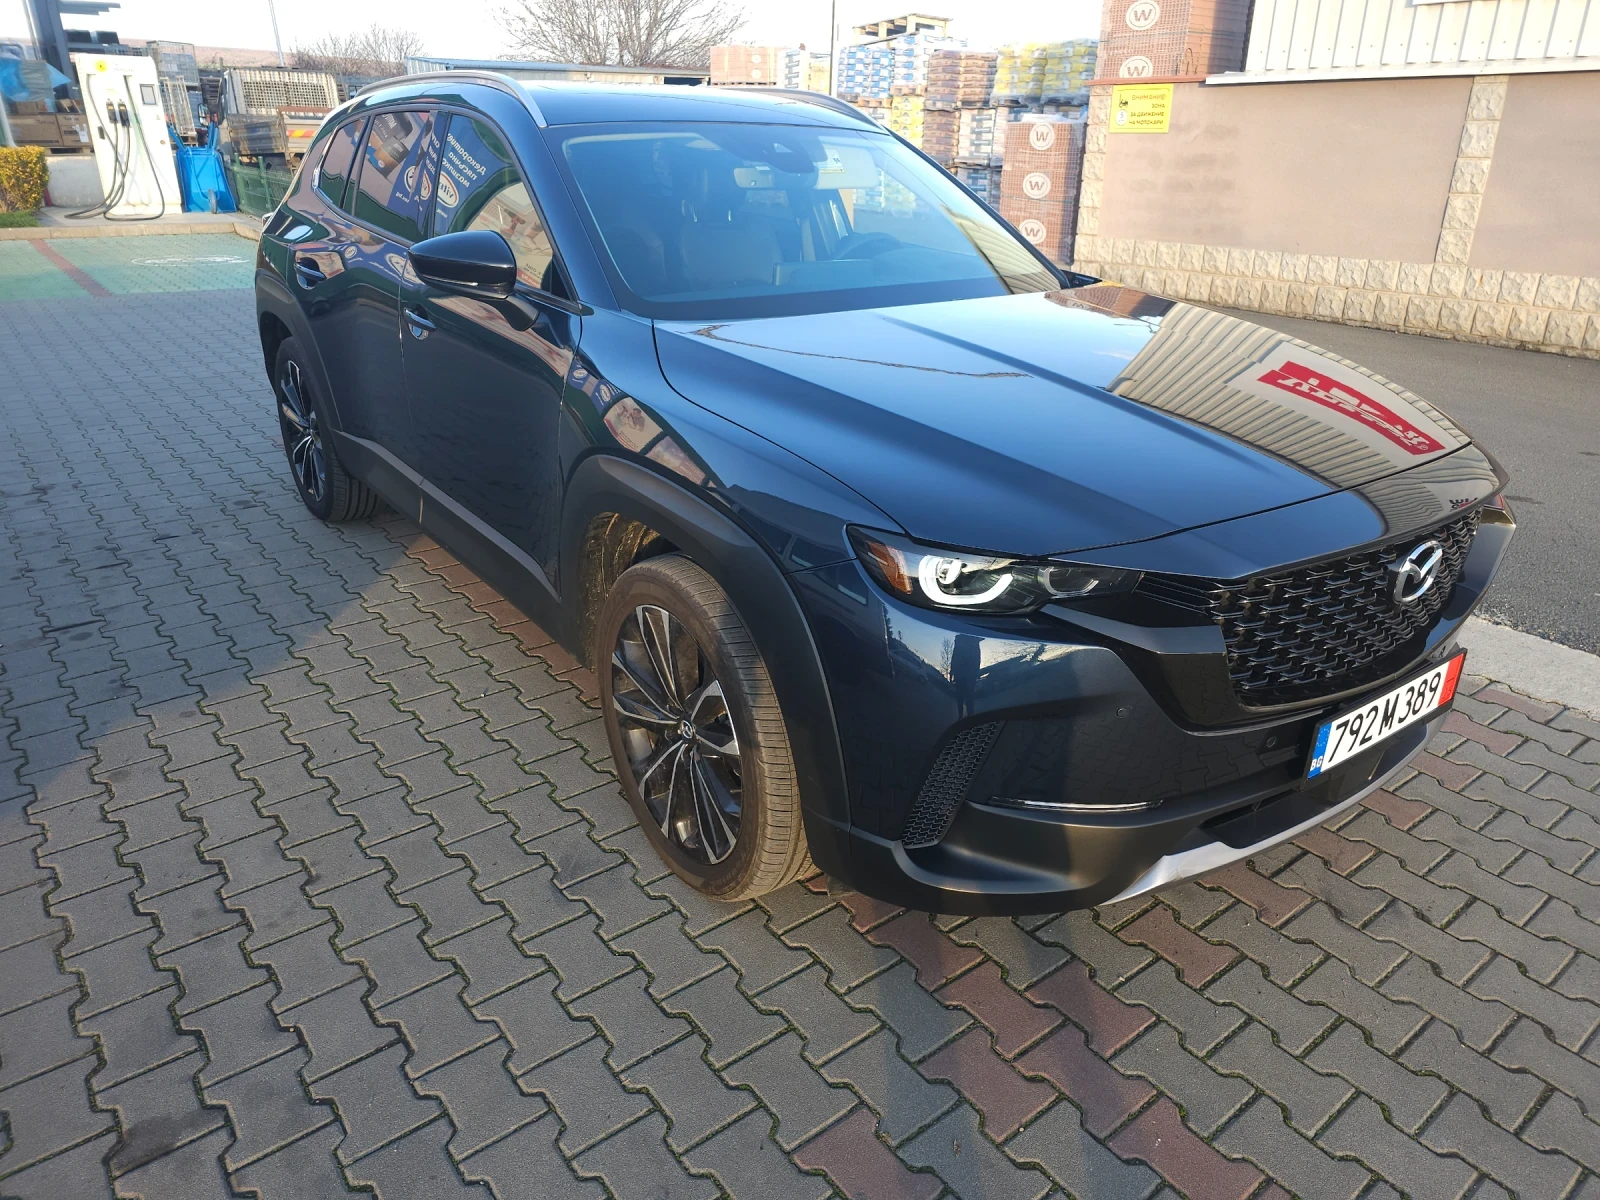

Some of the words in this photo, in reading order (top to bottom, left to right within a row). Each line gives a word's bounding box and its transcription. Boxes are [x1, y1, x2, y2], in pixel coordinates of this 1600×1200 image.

[1133, 8, 1153, 22] W
[1127, 65, 1147, 77] W
[1035, 130, 1050, 142] W
[1028, 180, 1046, 191] W
[1024, 226, 1041, 238] W
[1327, 671, 1442, 763] 792M389
[1310, 755, 1325, 770] BG
